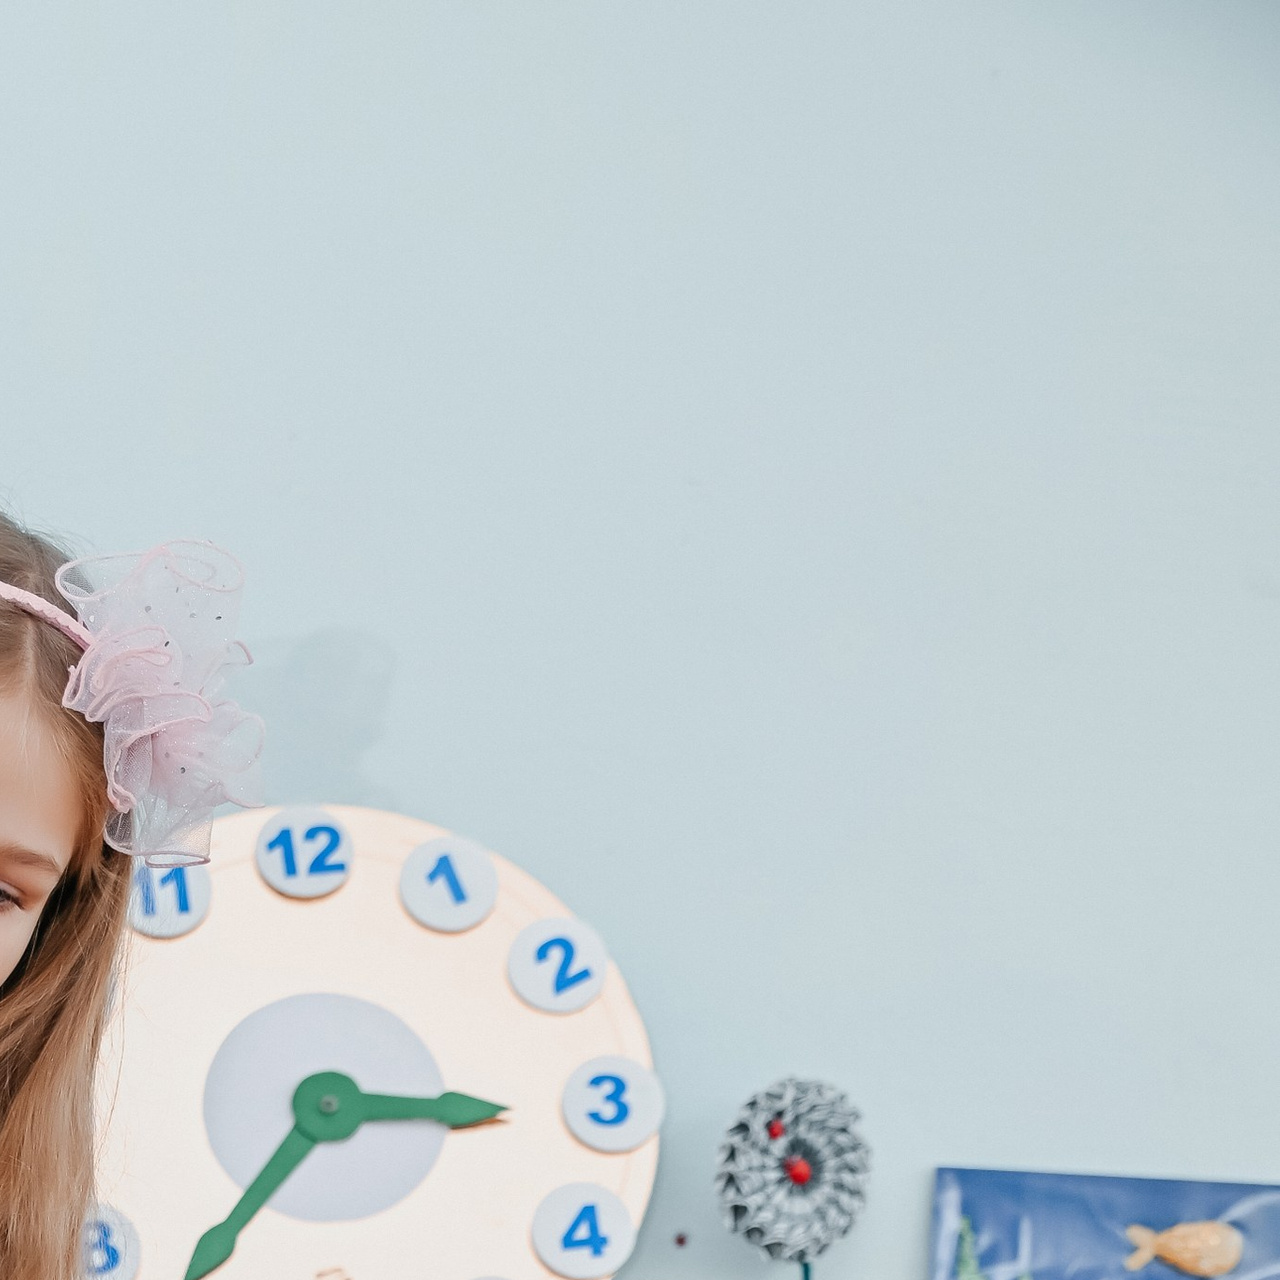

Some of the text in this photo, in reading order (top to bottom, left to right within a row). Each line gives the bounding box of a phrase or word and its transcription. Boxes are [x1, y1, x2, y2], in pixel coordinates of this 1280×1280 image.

[265, 823, 348, 879] 12
[135, 866, 192, 917] 11
[425, 853, 469, 906] 1
[533, 934, 593, 996] 2
[586, 1072, 632, 1128] 3
[559, 1202, 610, 1259] 4
